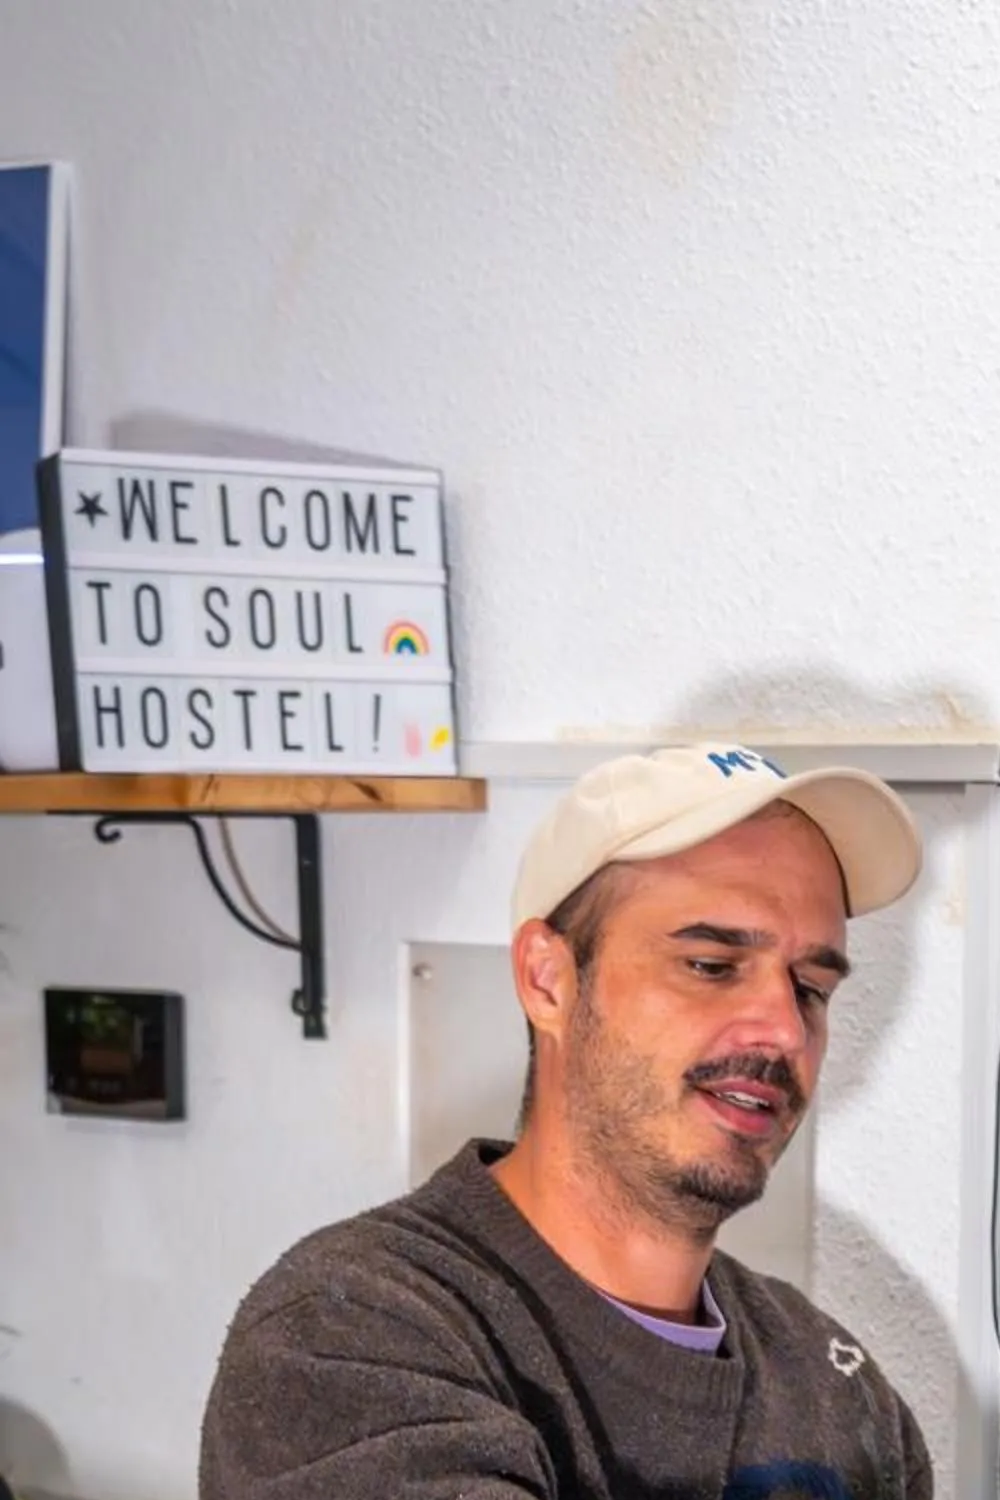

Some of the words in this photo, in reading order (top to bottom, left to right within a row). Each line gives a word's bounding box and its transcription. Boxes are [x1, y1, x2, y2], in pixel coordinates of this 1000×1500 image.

[117, 477, 416, 556] WELCOME
[86, 581, 163, 647] TO
[203, 586, 363, 653] SOUL
[93, 686, 381, 753] HOSTEL!
